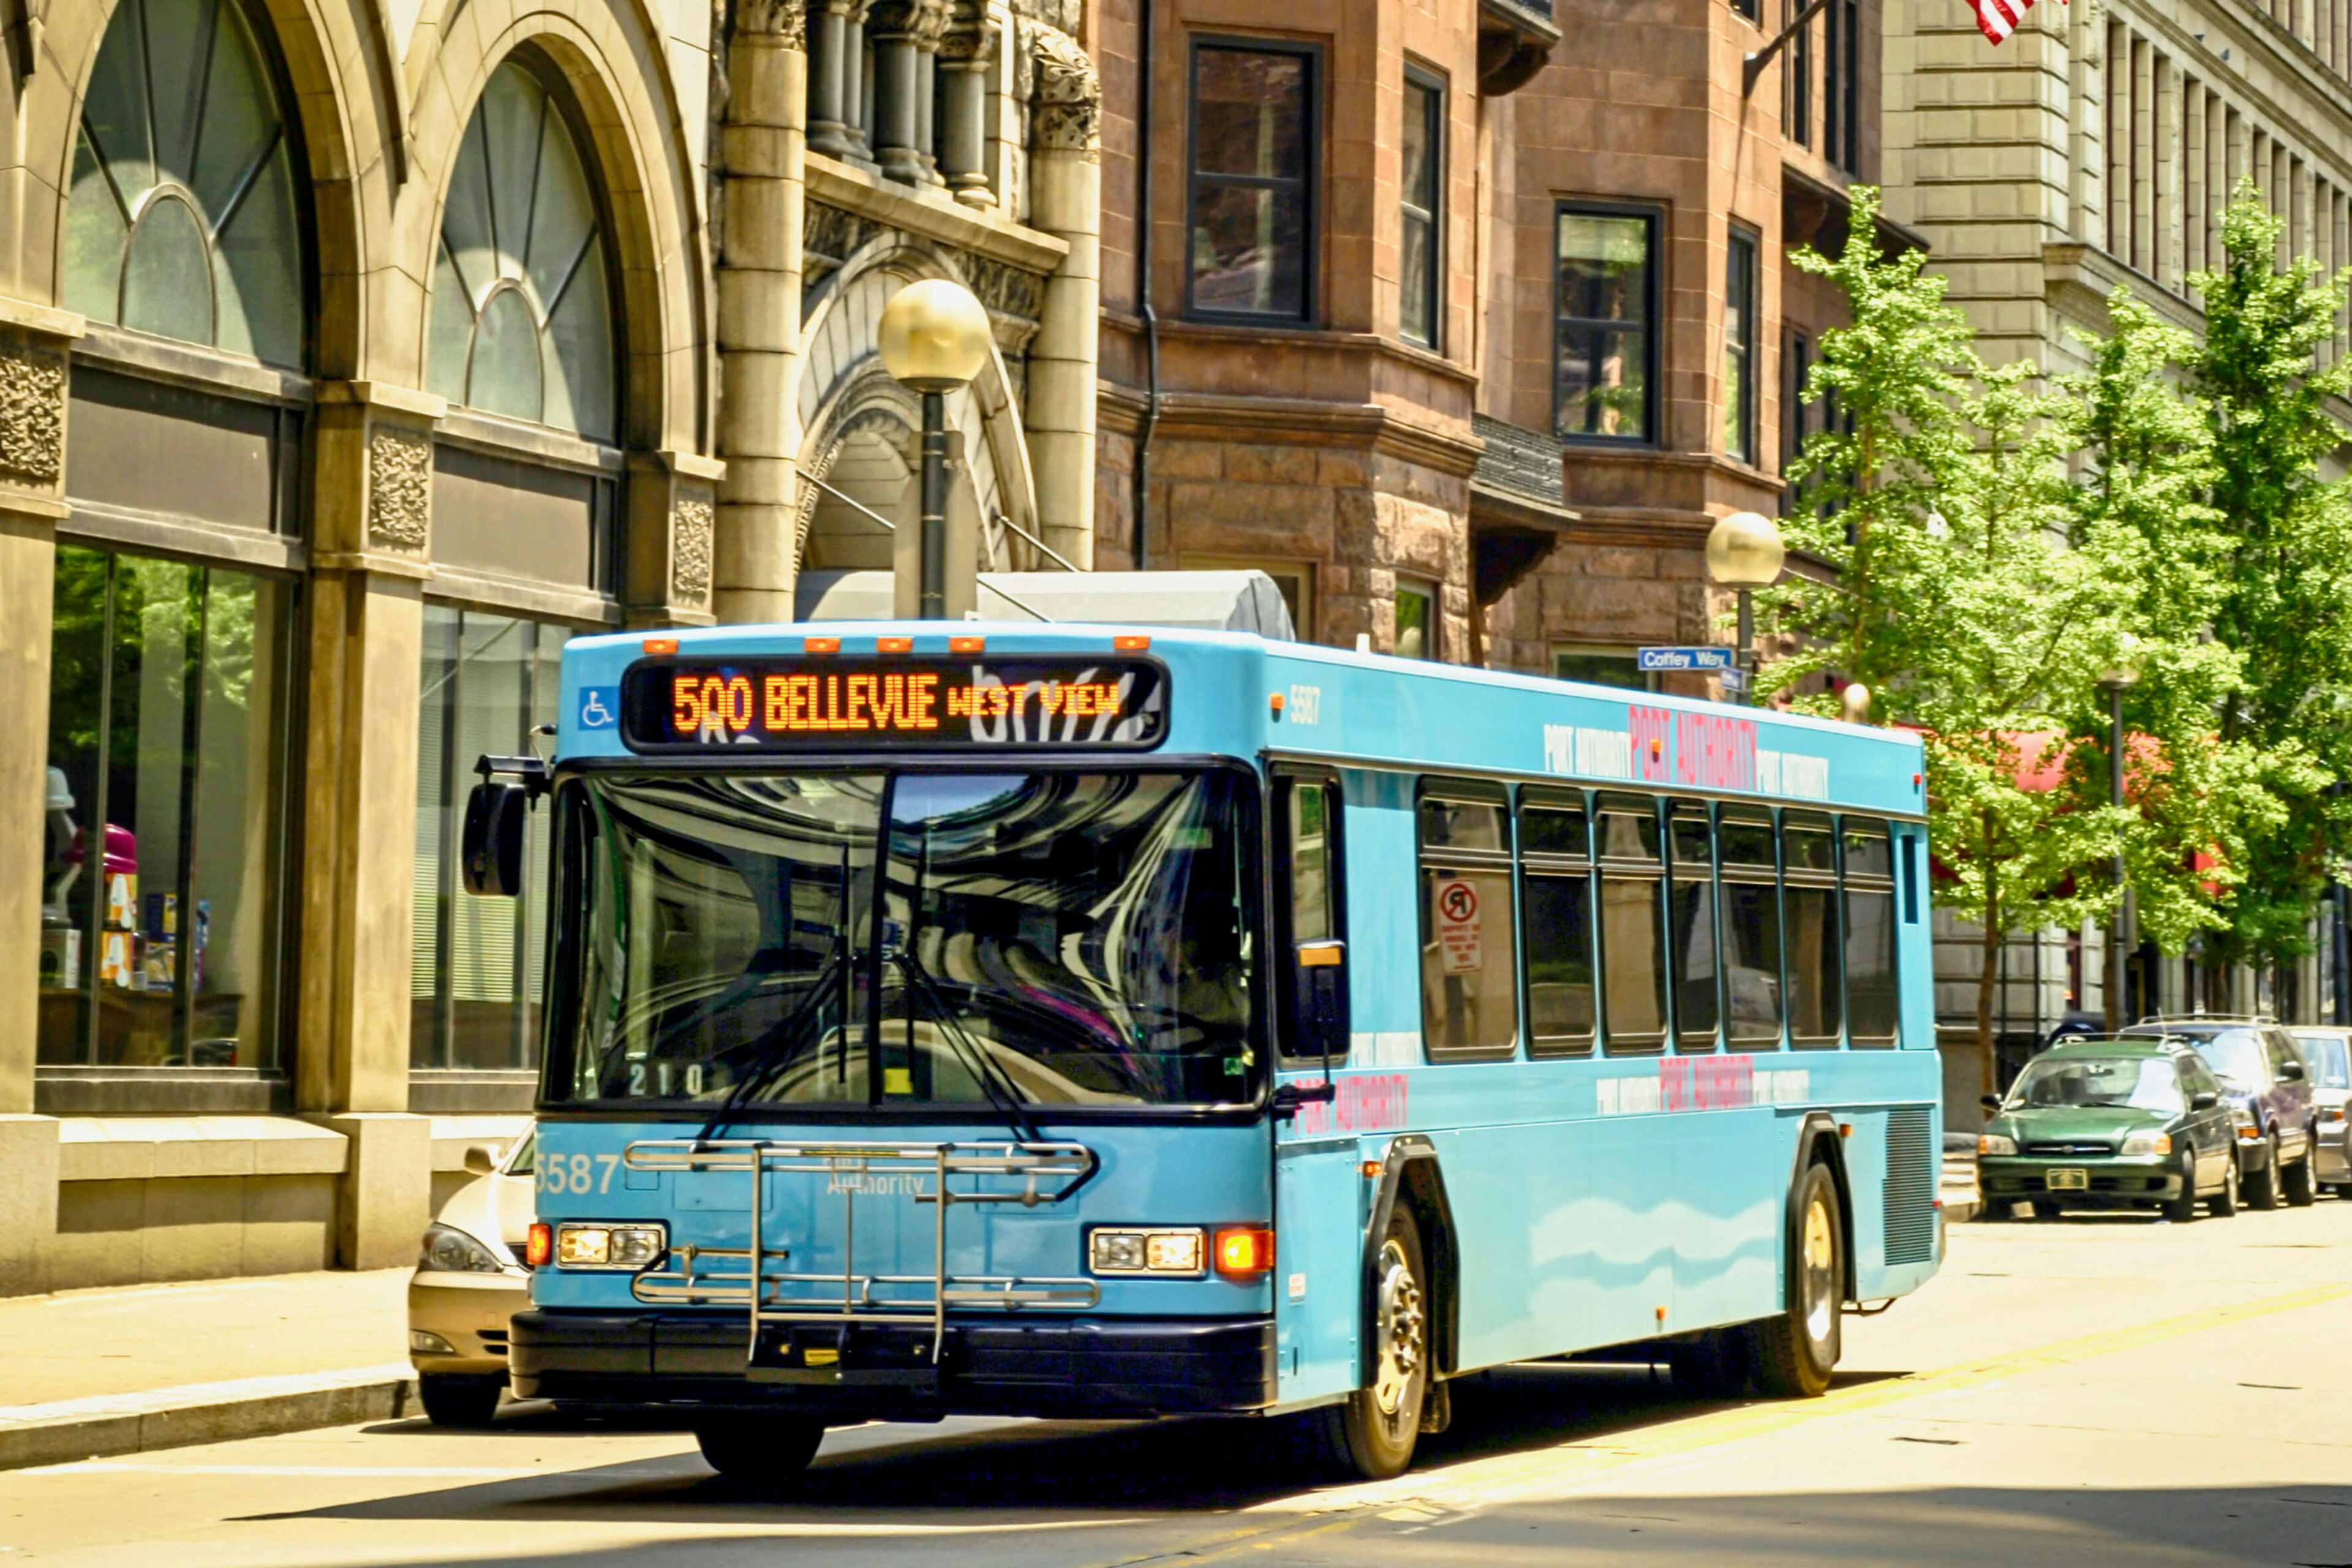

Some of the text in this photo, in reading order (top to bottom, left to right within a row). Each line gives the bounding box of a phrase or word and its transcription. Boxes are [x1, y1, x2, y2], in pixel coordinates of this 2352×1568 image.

[1644, 650, 1725, 668] Coffey Way
[675, 675, 1120, 730] 500 BELLEVUE WEST VIEW
[1629, 704, 1671, 782] PORT
[1676, 710, 1758, 791] AUTHORITY
[629, 1063, 703, 1095] 210
